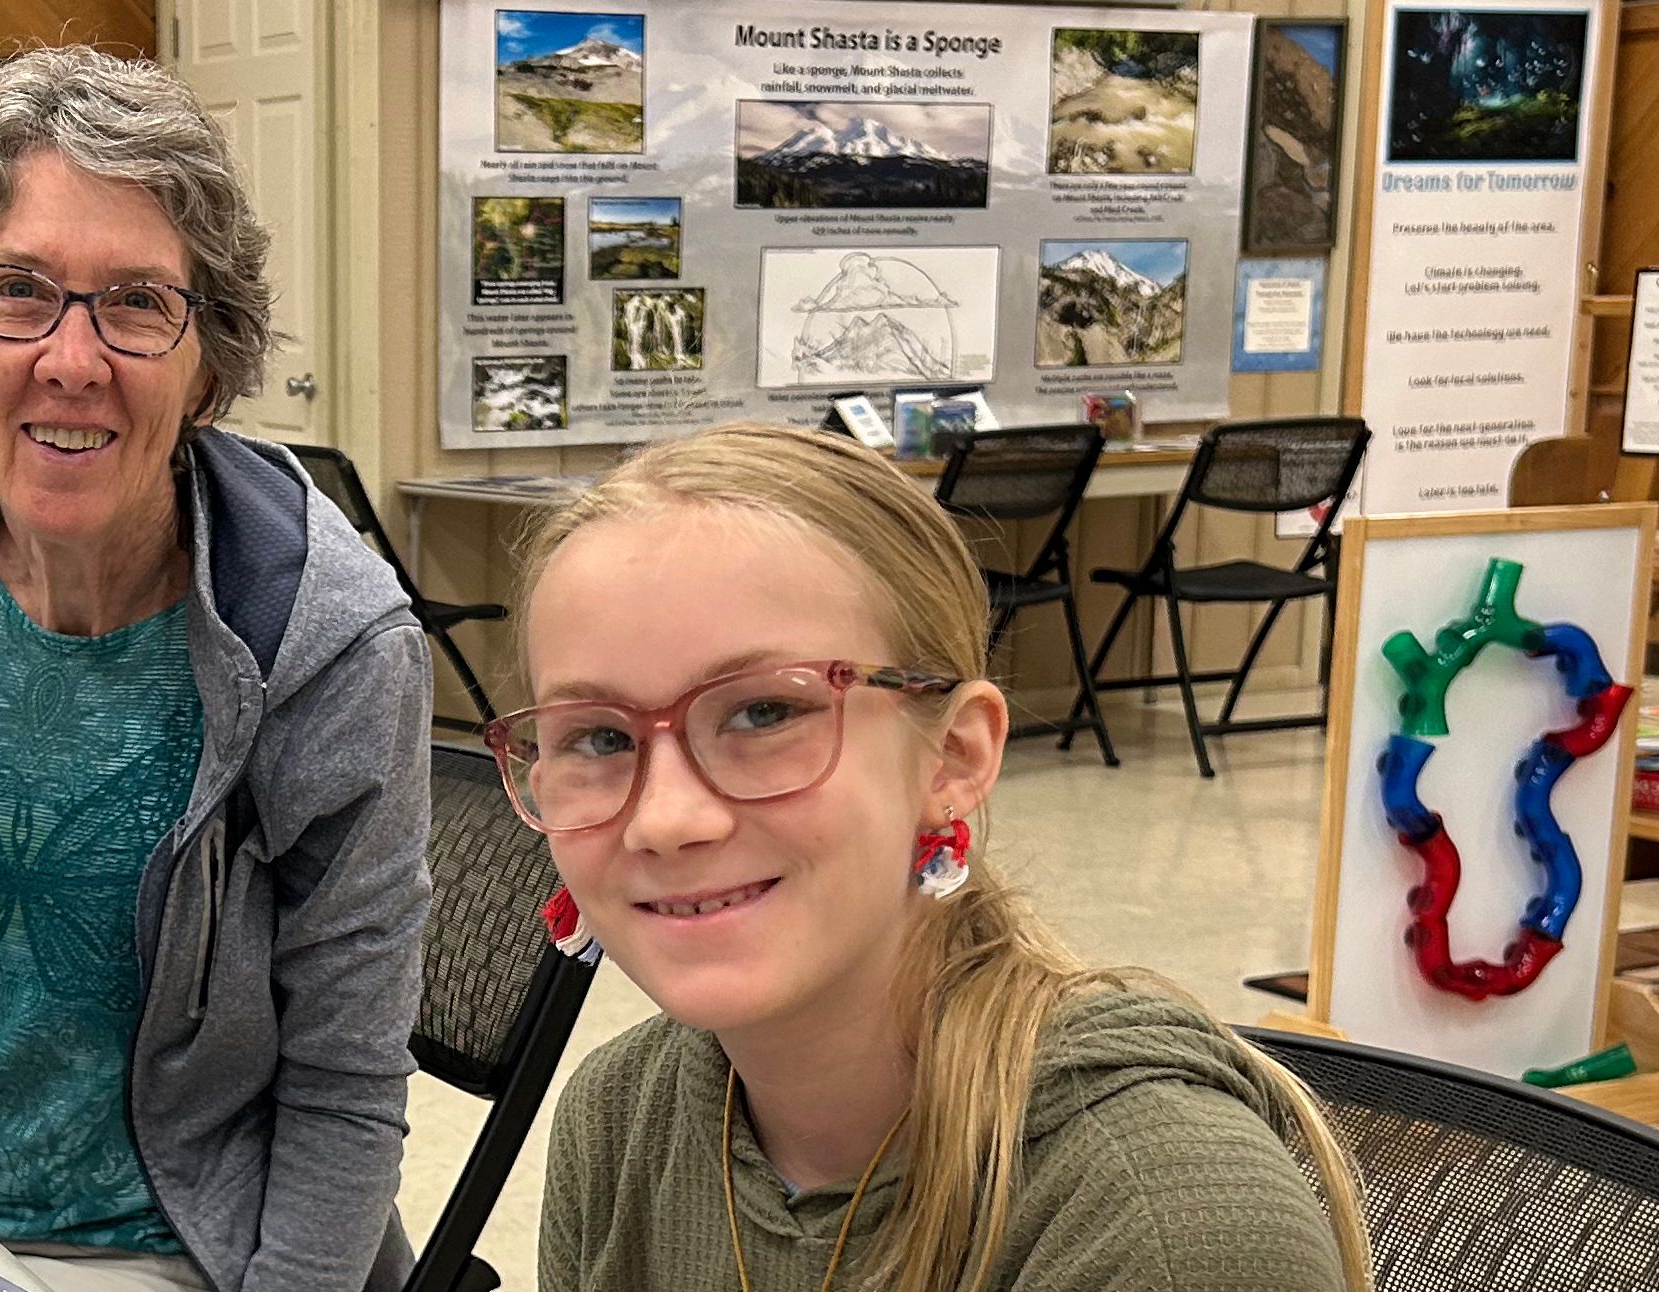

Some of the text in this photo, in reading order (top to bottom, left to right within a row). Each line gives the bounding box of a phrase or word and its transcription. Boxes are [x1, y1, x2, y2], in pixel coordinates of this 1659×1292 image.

[735, 25, 1002, 58] Mount Shasta is a Sponge
[773, 63, 795, 75] Like
[849, 64, 884, 76] Mount
[887, 64, 921, 77] Shasta
[923, 66, 964, 79] collects
[860, 82, 881, 95] and
[883, 83, 916, 96] glacial
[1382, 171, 1577, 193] Dreams for Tomorrow
[1441, 221, 1458, 233] the
[1459, 221, 1496, 236] beauty
[1497, 221, 1509, 233] of
[1511, 220, 1528, 232] the
[1404, 330, 1429, 342] have
[1431, 329, 1449, 340] the
[1450, 327, 1505, 343] technology
[1408, 374, 1432, 387] Look
